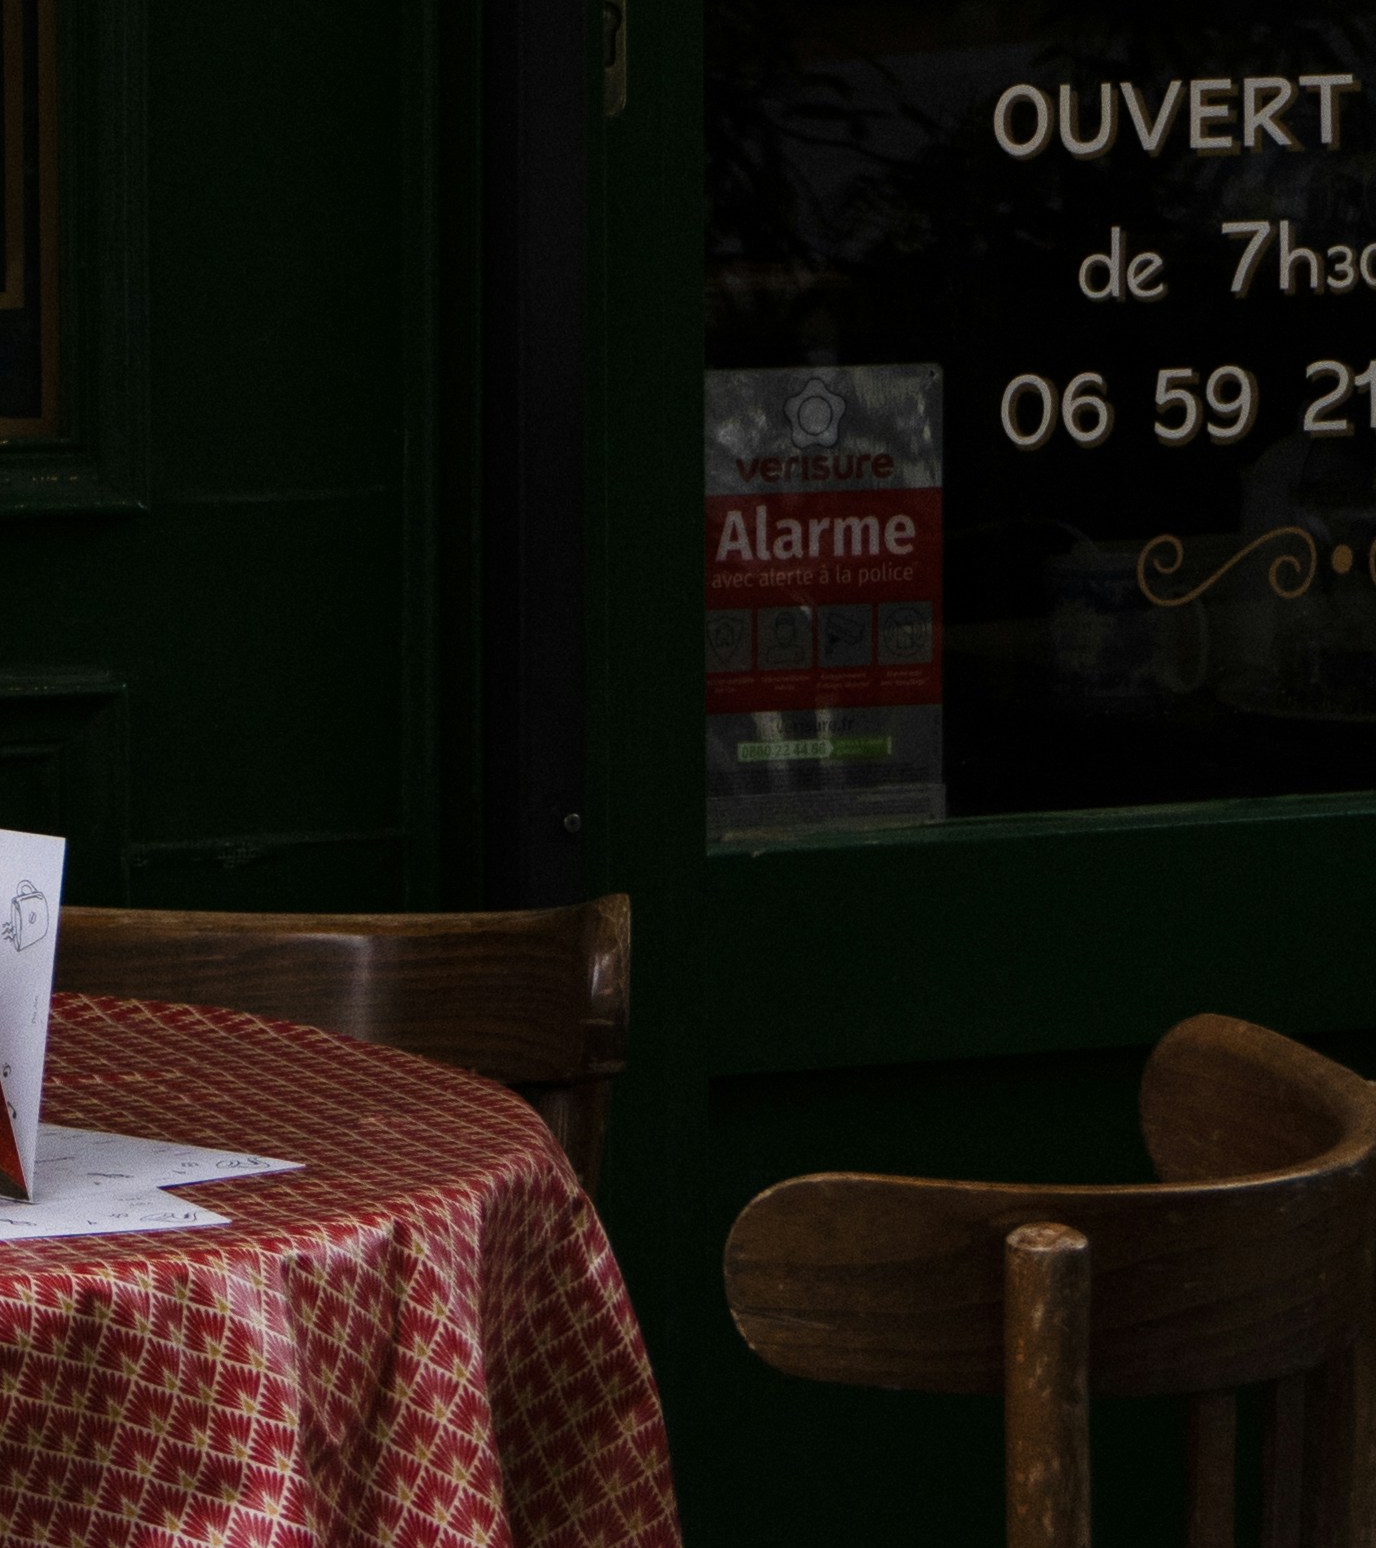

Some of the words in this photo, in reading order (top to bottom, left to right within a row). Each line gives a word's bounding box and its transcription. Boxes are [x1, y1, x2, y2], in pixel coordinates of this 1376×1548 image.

[993, 73, 1360, 161] OUVERT
[1077, 224, 1169, 302] de
[1000, 371, 1116, 451] 06
[1154, 364, 1261, 448] 59
[735, 453, 895, 483] verisure
[714, 504, 916, 563] Alarme
[711, 572, 756, 589] avec
[759, 568, 814, 587] alerte
[818, 564, 830, 585] à
[836, 564, 852, 584] la
